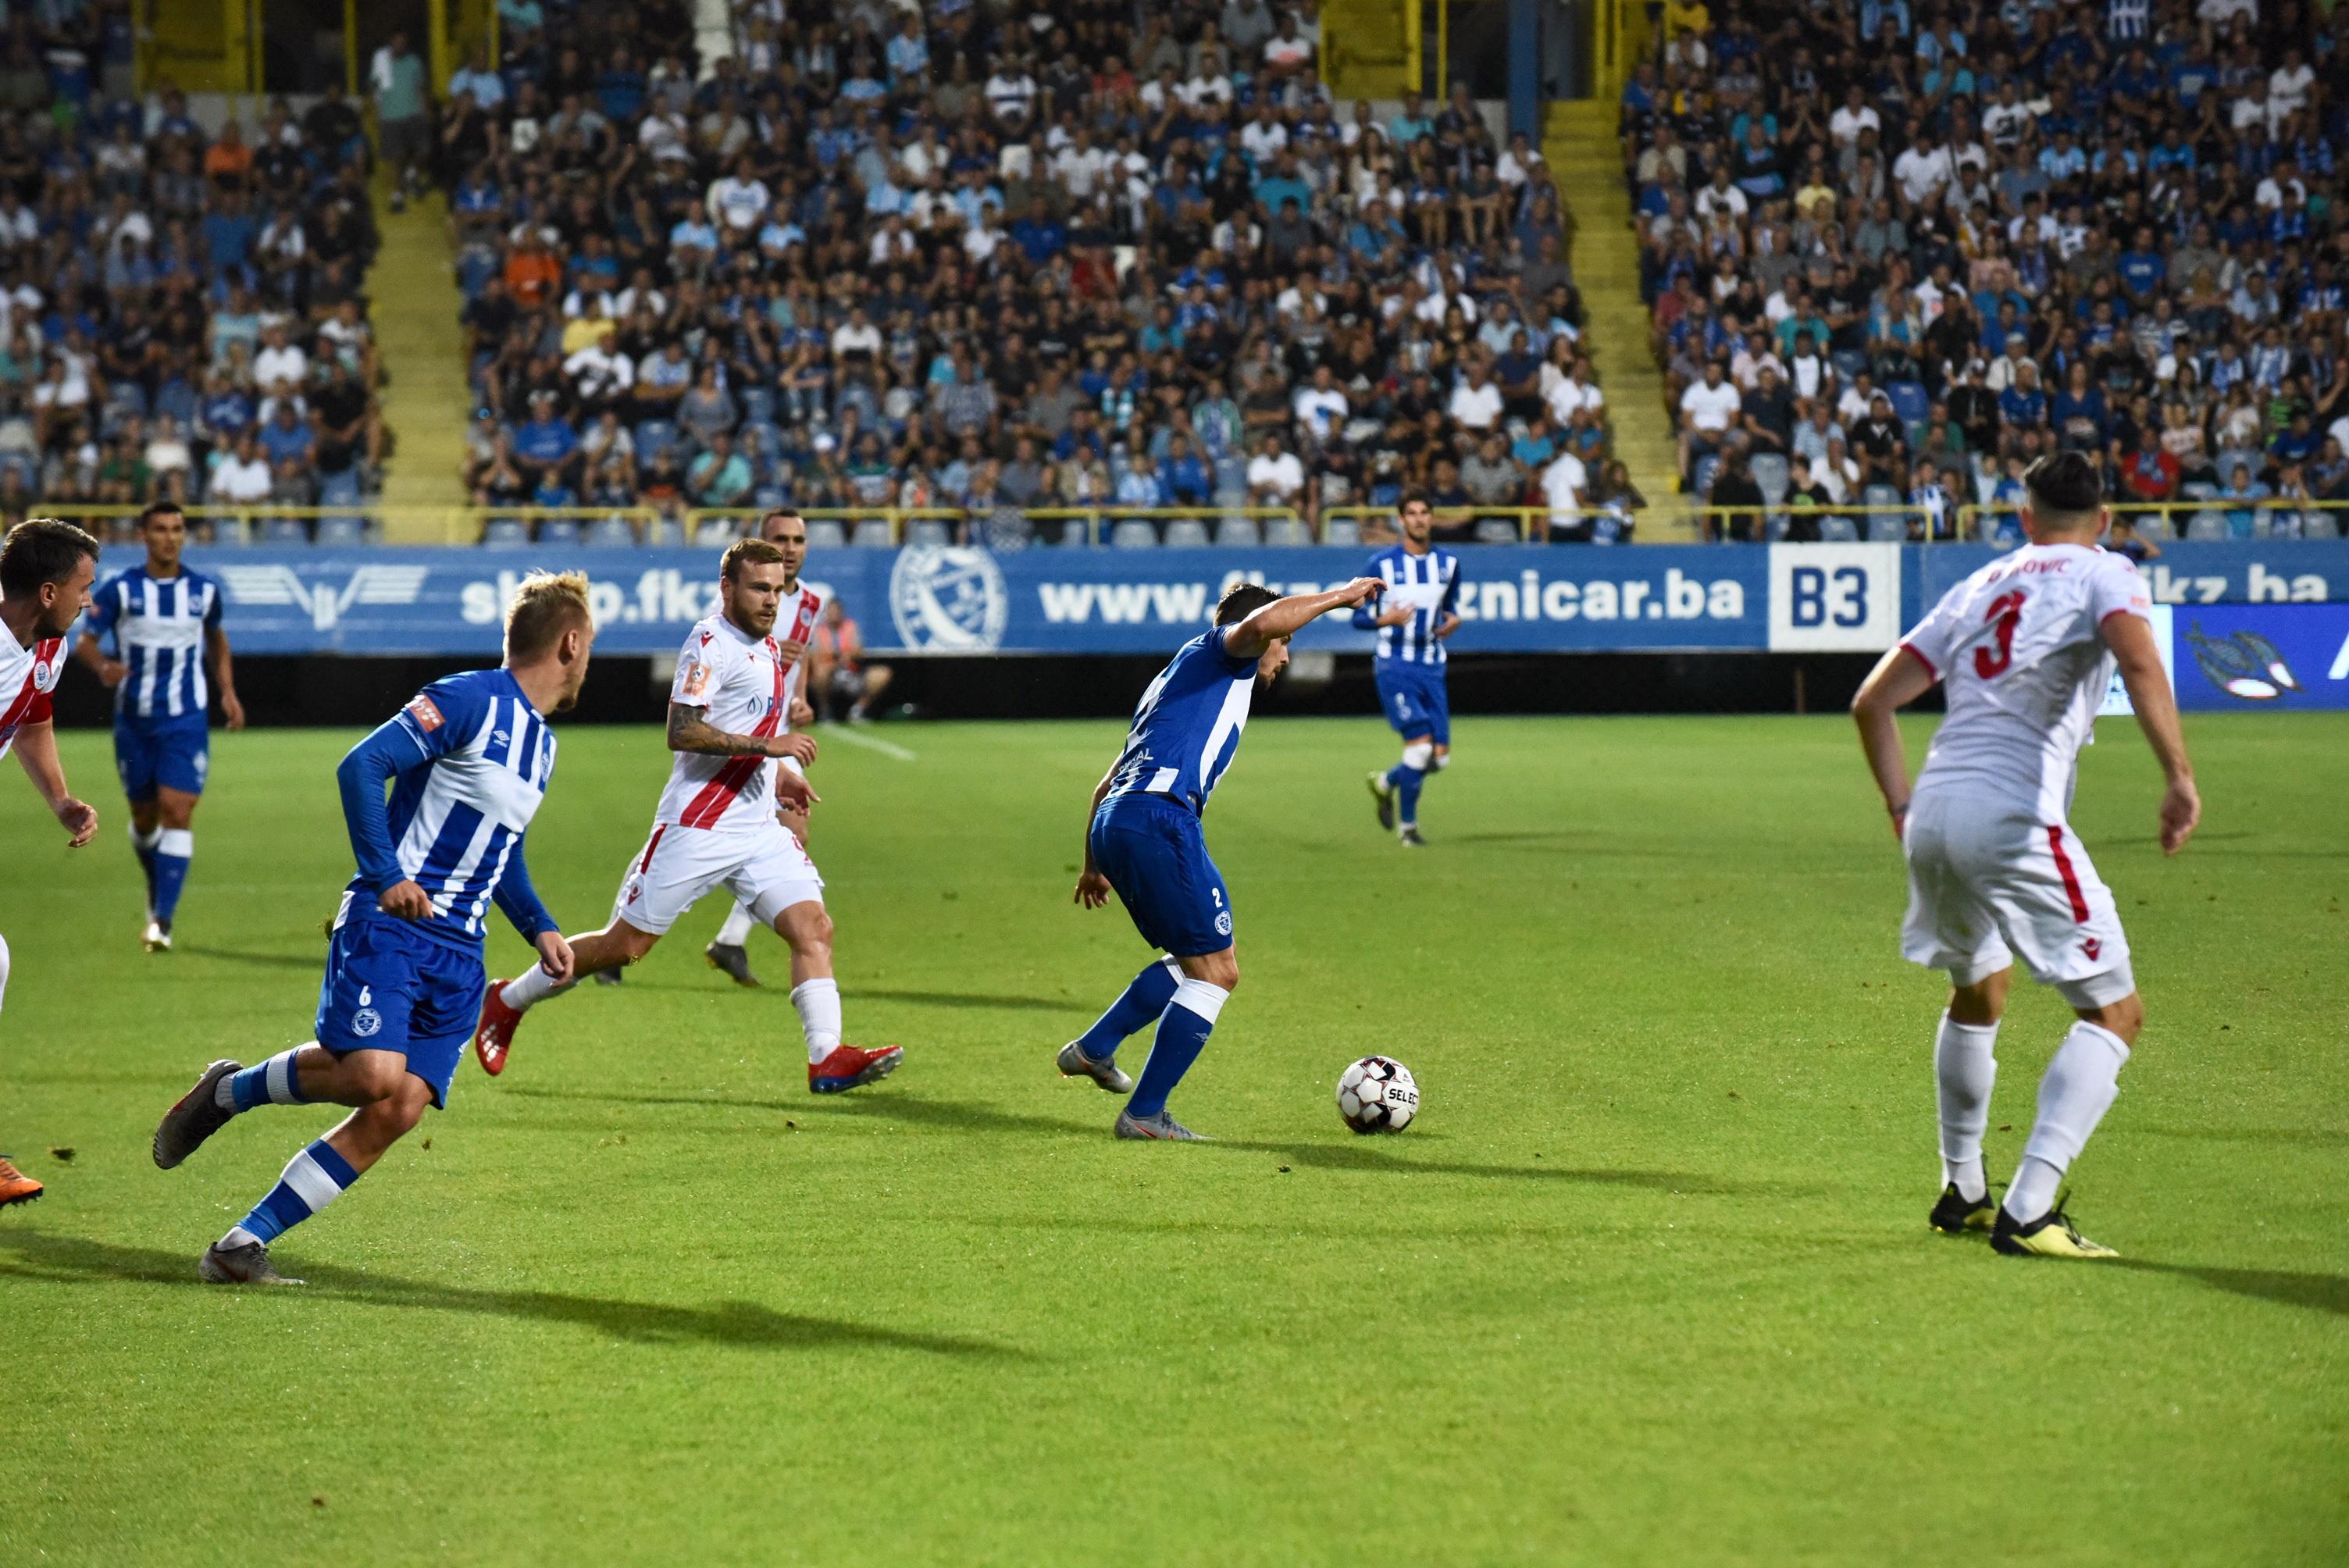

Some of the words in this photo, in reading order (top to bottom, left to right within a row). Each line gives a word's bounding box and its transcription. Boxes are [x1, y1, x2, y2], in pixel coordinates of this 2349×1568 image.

[1791, 566, 1867, 627] B3
[1974, 590, 2026, 680] 3
[1212, 888, 1223, 908] 2
[359, 985, 371, 1007] 6
